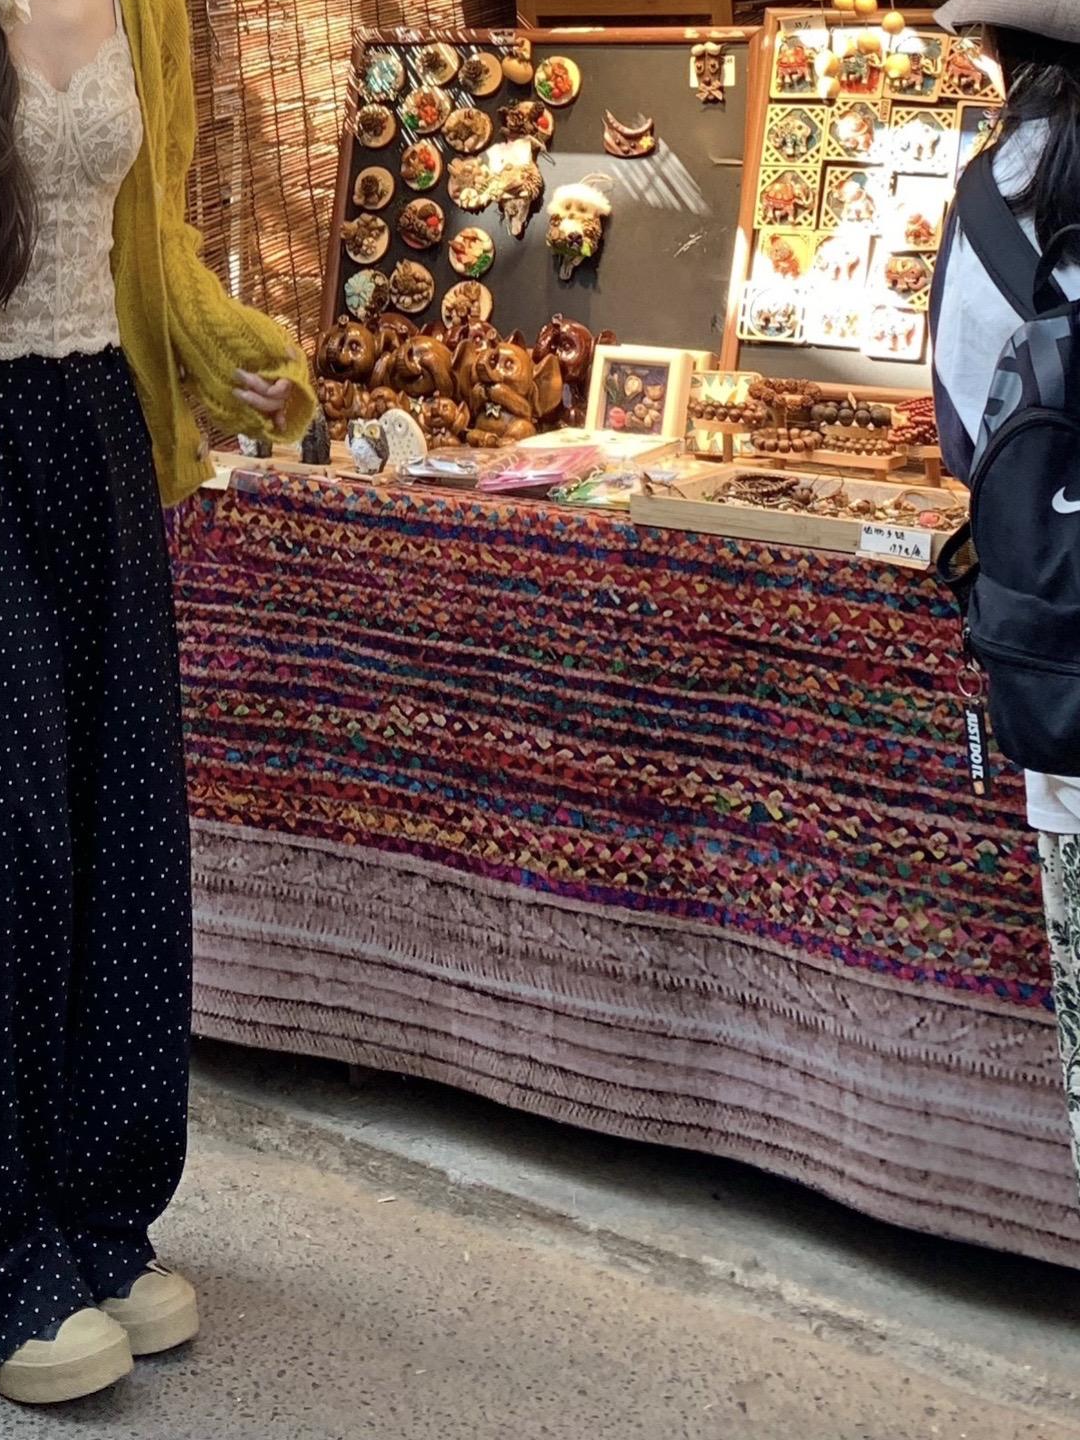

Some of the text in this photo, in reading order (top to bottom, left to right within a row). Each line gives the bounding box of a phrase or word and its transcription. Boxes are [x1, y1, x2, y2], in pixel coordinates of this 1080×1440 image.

[965, 709, 984, 780] JUST DO IT
